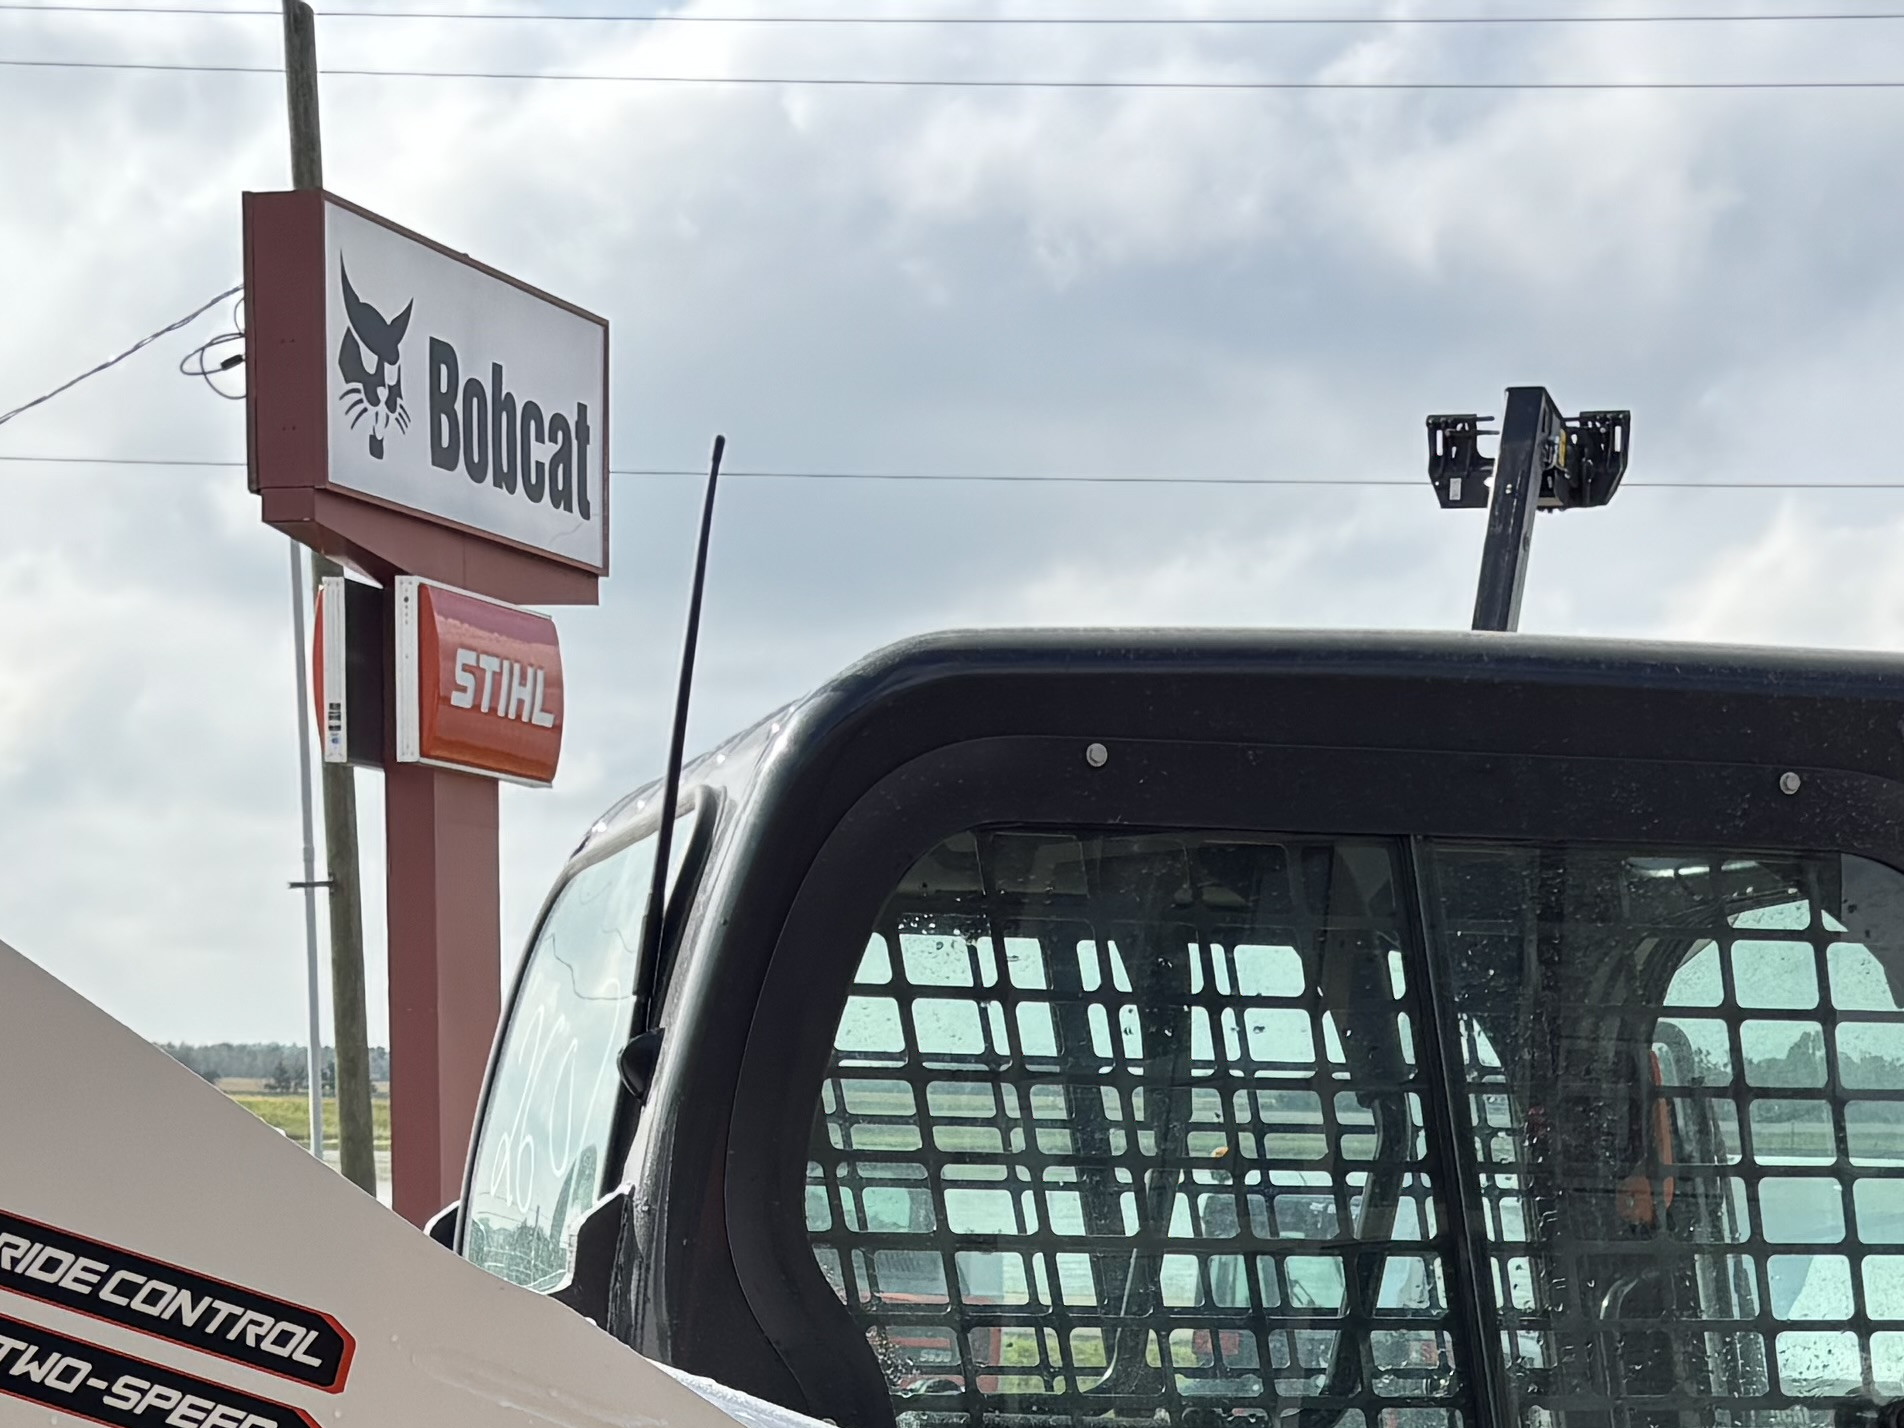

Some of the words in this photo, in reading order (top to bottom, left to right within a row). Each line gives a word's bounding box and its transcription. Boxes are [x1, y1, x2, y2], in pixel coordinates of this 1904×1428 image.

[428, 335, 591, 521] Bobcat
[450, 648, 555, 729] STIHL
[98, 1269, 324, 1368] CONTROL
